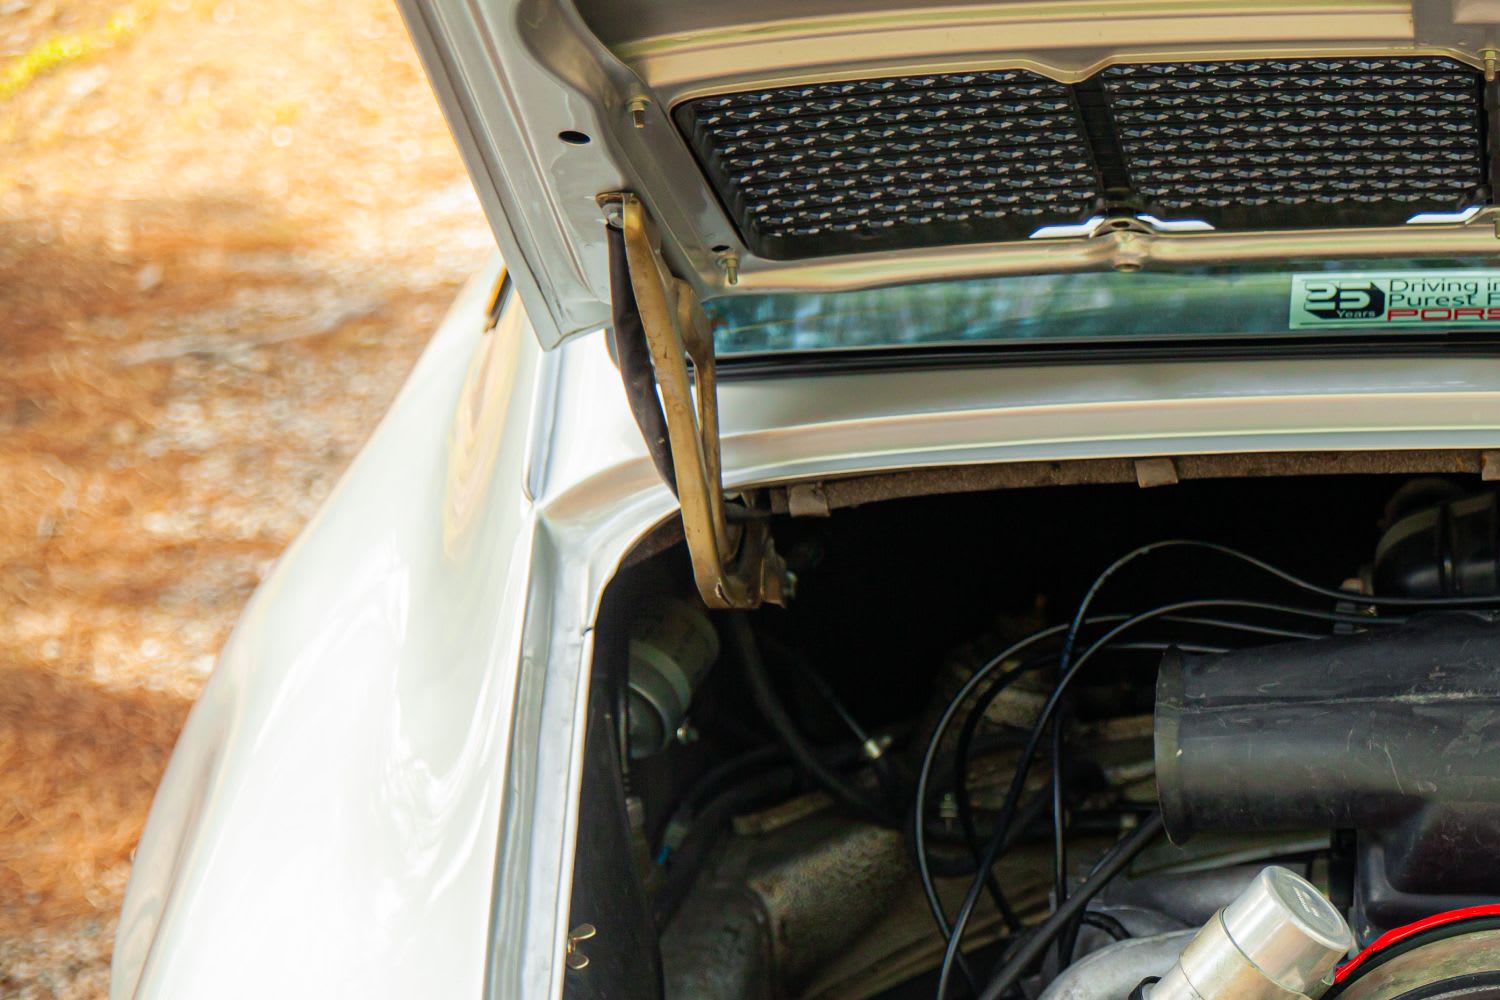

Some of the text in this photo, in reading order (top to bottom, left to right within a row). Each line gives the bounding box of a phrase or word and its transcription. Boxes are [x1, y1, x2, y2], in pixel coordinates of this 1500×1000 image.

[1389, 279, 1479, 294] Driving
[1304, 281, 1371, 312] 25
[1389, 292, 1475, 308] Purest
[1335, 309, 1376, 319] Years
